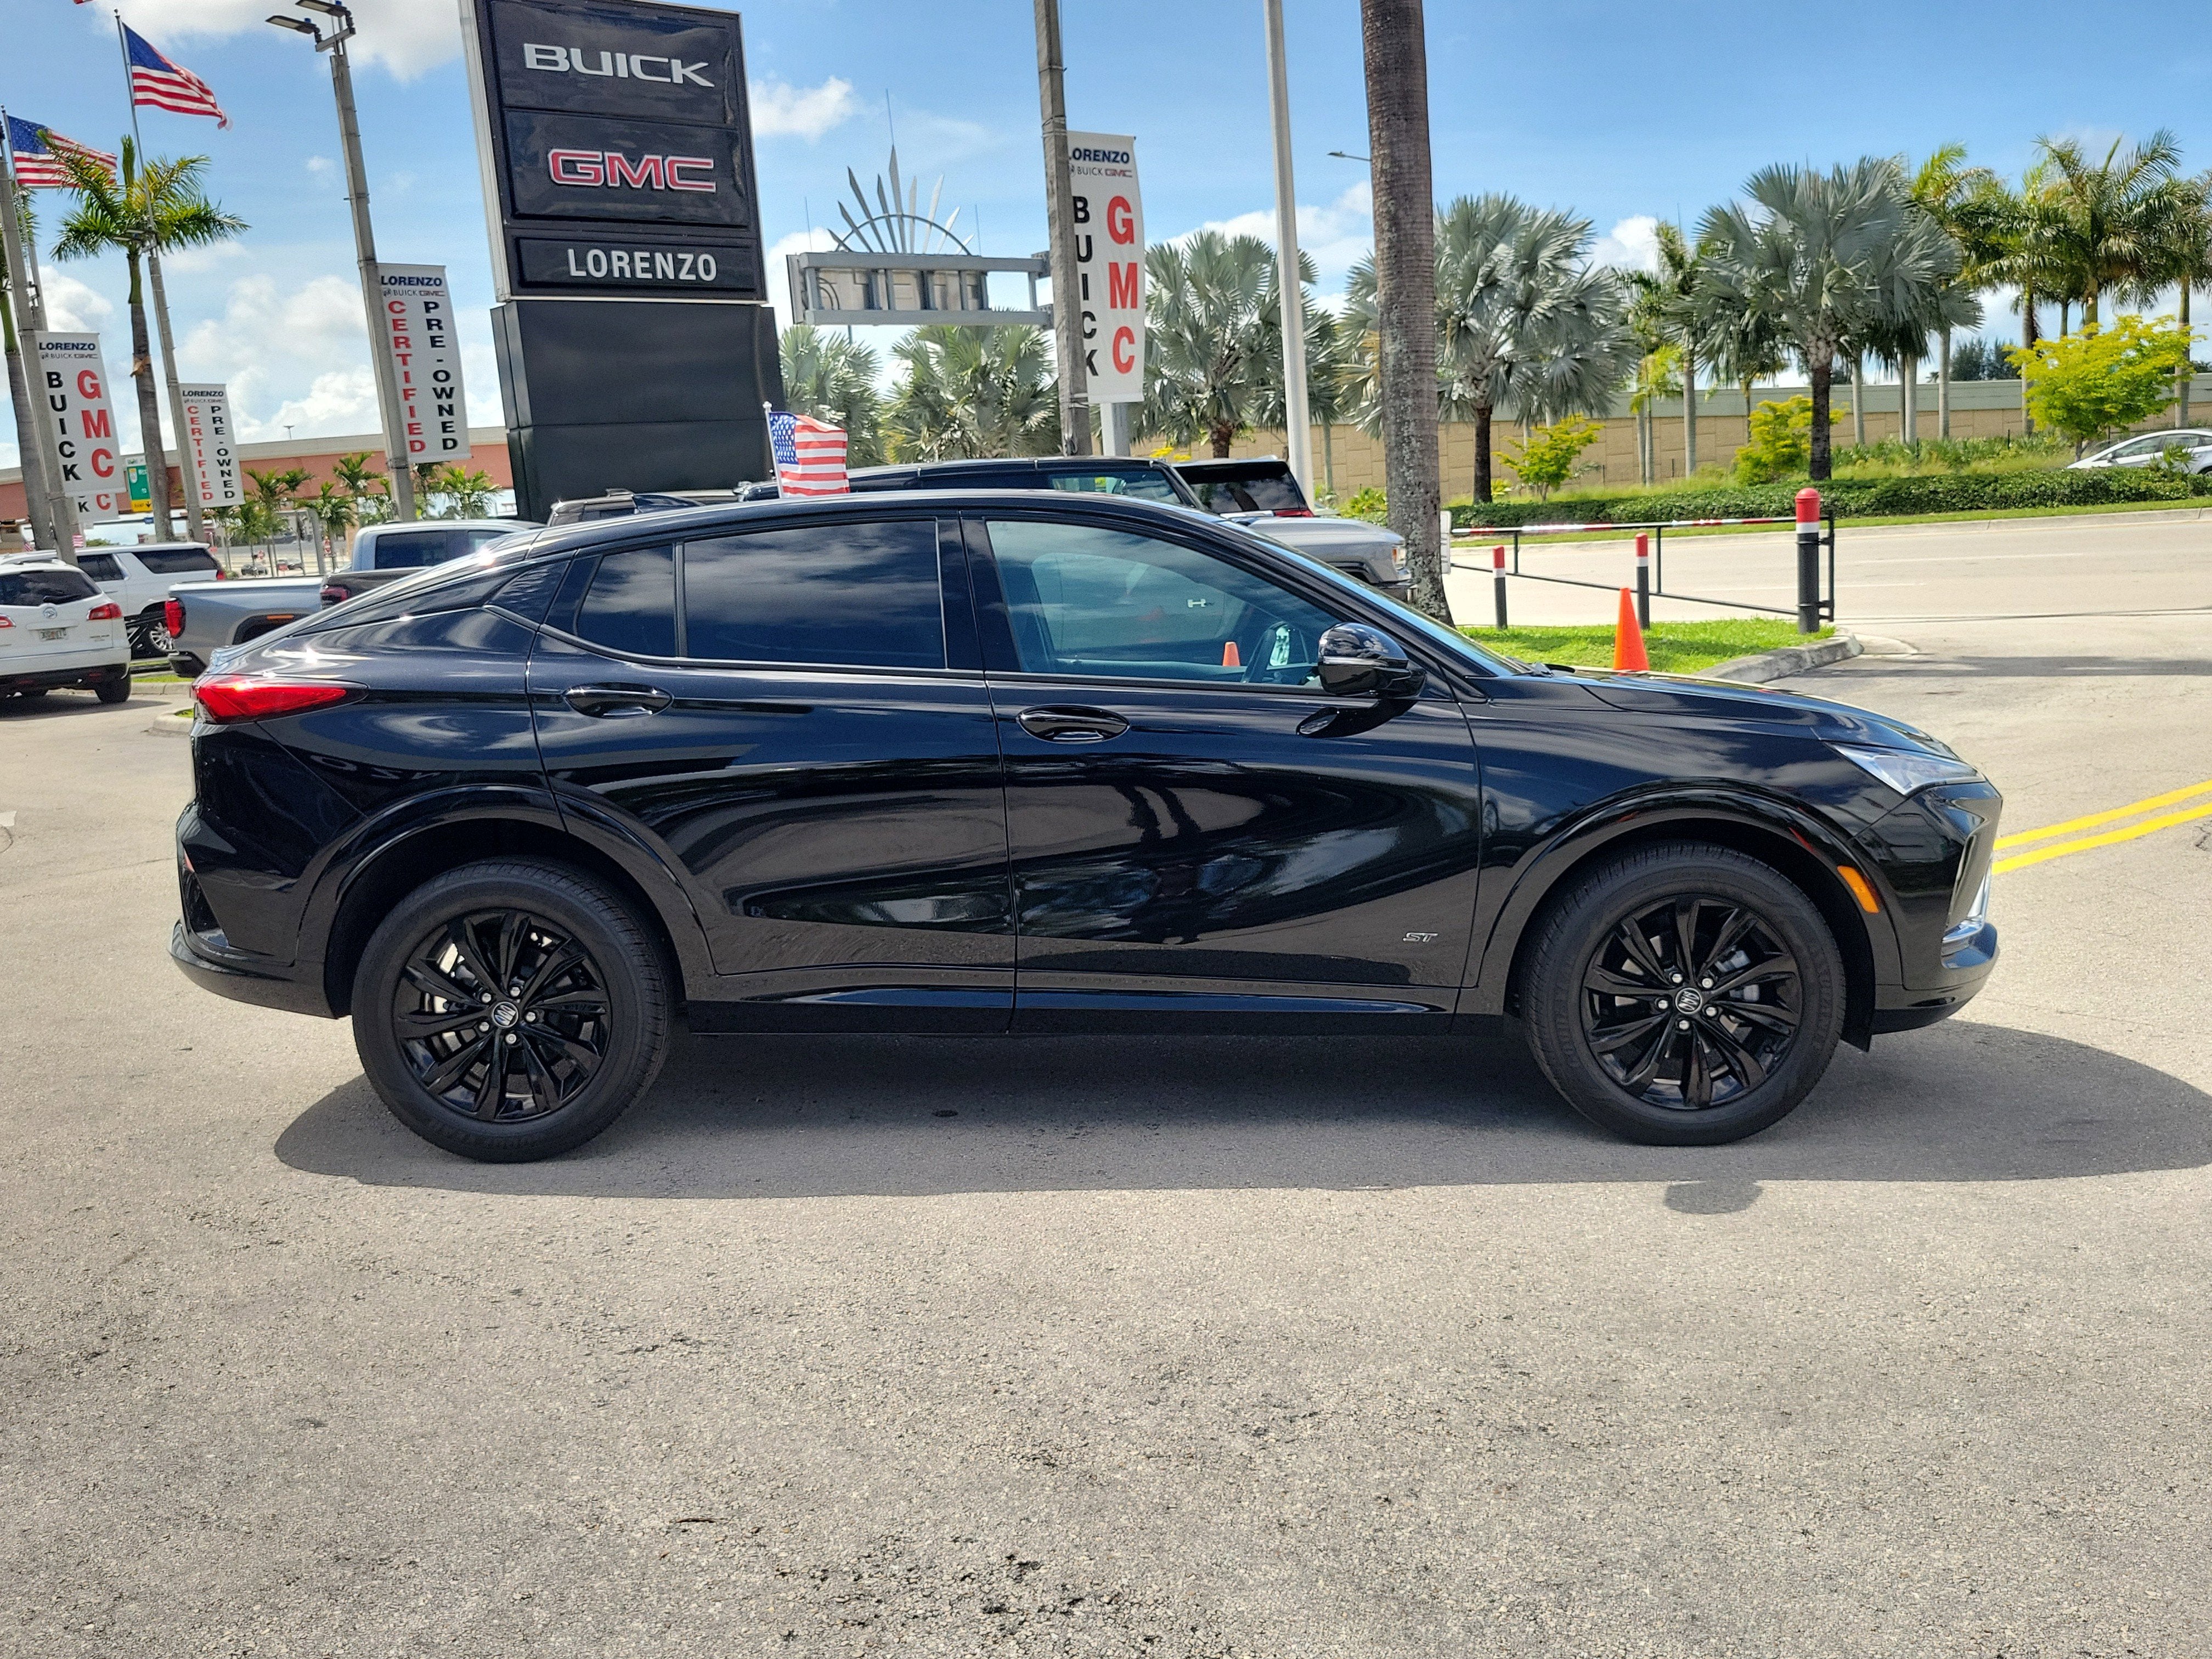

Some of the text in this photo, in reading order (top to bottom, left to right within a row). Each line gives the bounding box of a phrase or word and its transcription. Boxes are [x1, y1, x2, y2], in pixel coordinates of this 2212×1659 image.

[523, 43, 715, 87] BUICK
[548, 149, 716, 193] GMC
[1069, 147, 1130, 164] ORENZO
[1077, 166, 1132, 178] BUICK GMC
[381, 275, 442, 286] LORENZO
[567, 249, 717, 281] LORENZO
[1107, 195, 1138, 375] GMC
[39, 342, 96, 351] LORENZO
[388, 300, 426, 453] CERTIFIED
[424, 301, 458, 451] PRE-OWNED
[46, 371, 82, 482] BUICK
[77, 369, 115, 478] GMC
[187, 405, 214, 500] CERTIFIED
[211, 405, 236, 499] PRE-OWNED
[1403, 932, 1438, 943] ST
